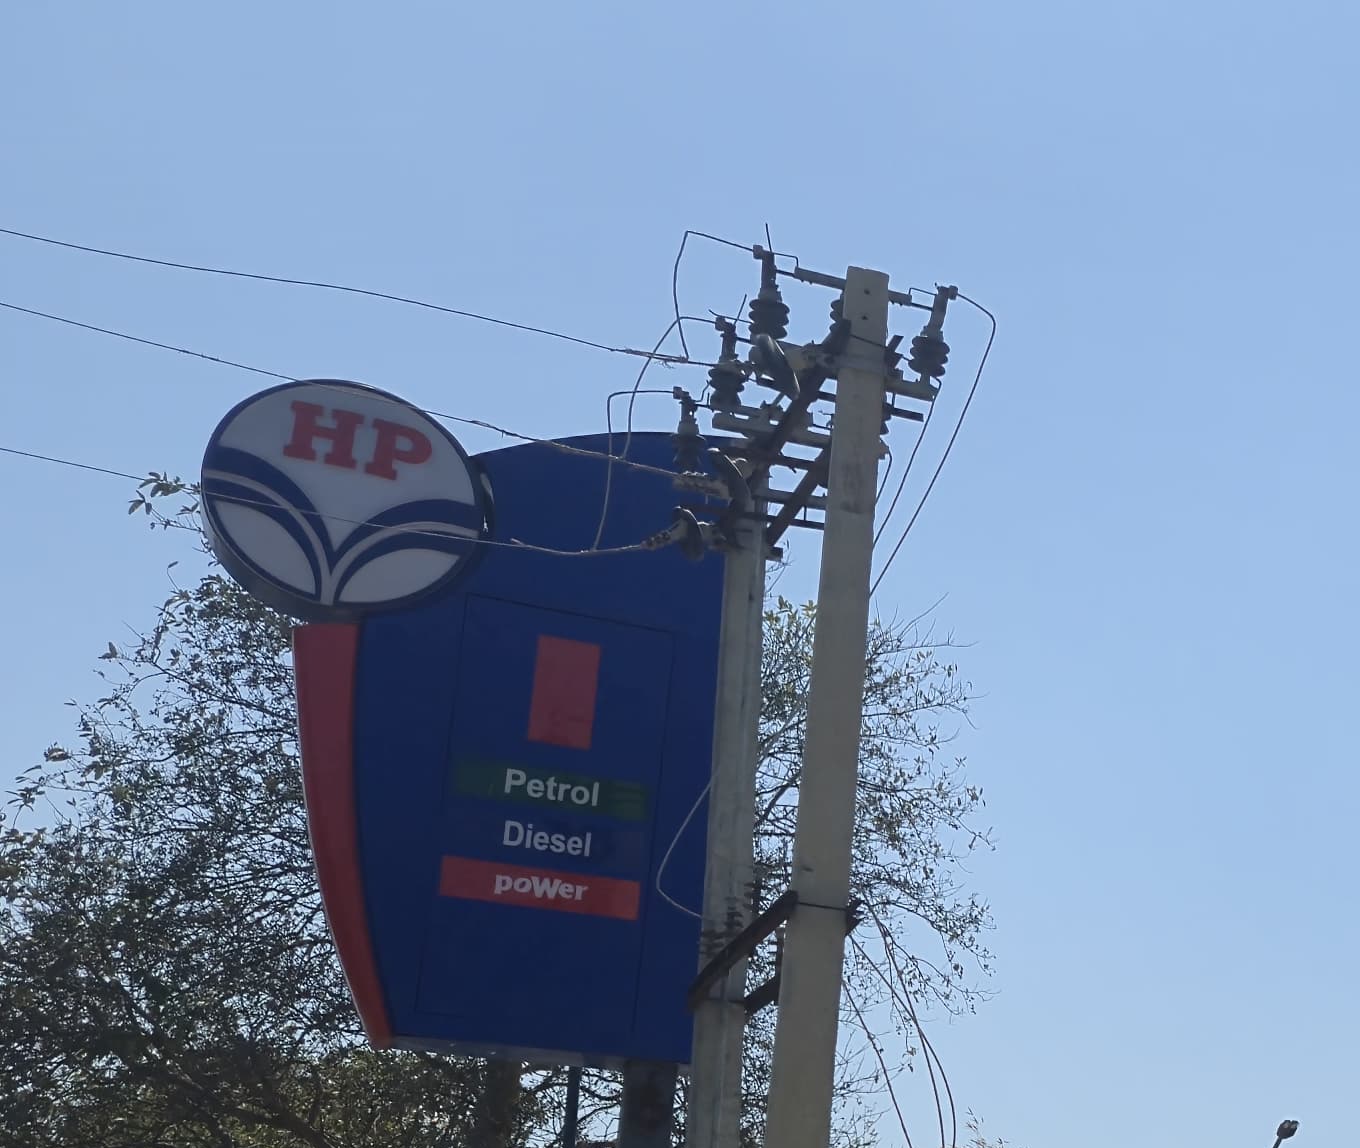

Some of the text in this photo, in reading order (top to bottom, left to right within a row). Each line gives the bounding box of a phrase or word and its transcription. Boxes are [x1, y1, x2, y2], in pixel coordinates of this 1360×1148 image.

[282, 399, 434, 482] HP
[503, 767, 600, 807] Petrol
[502, 819, 592, 858] Diesel
